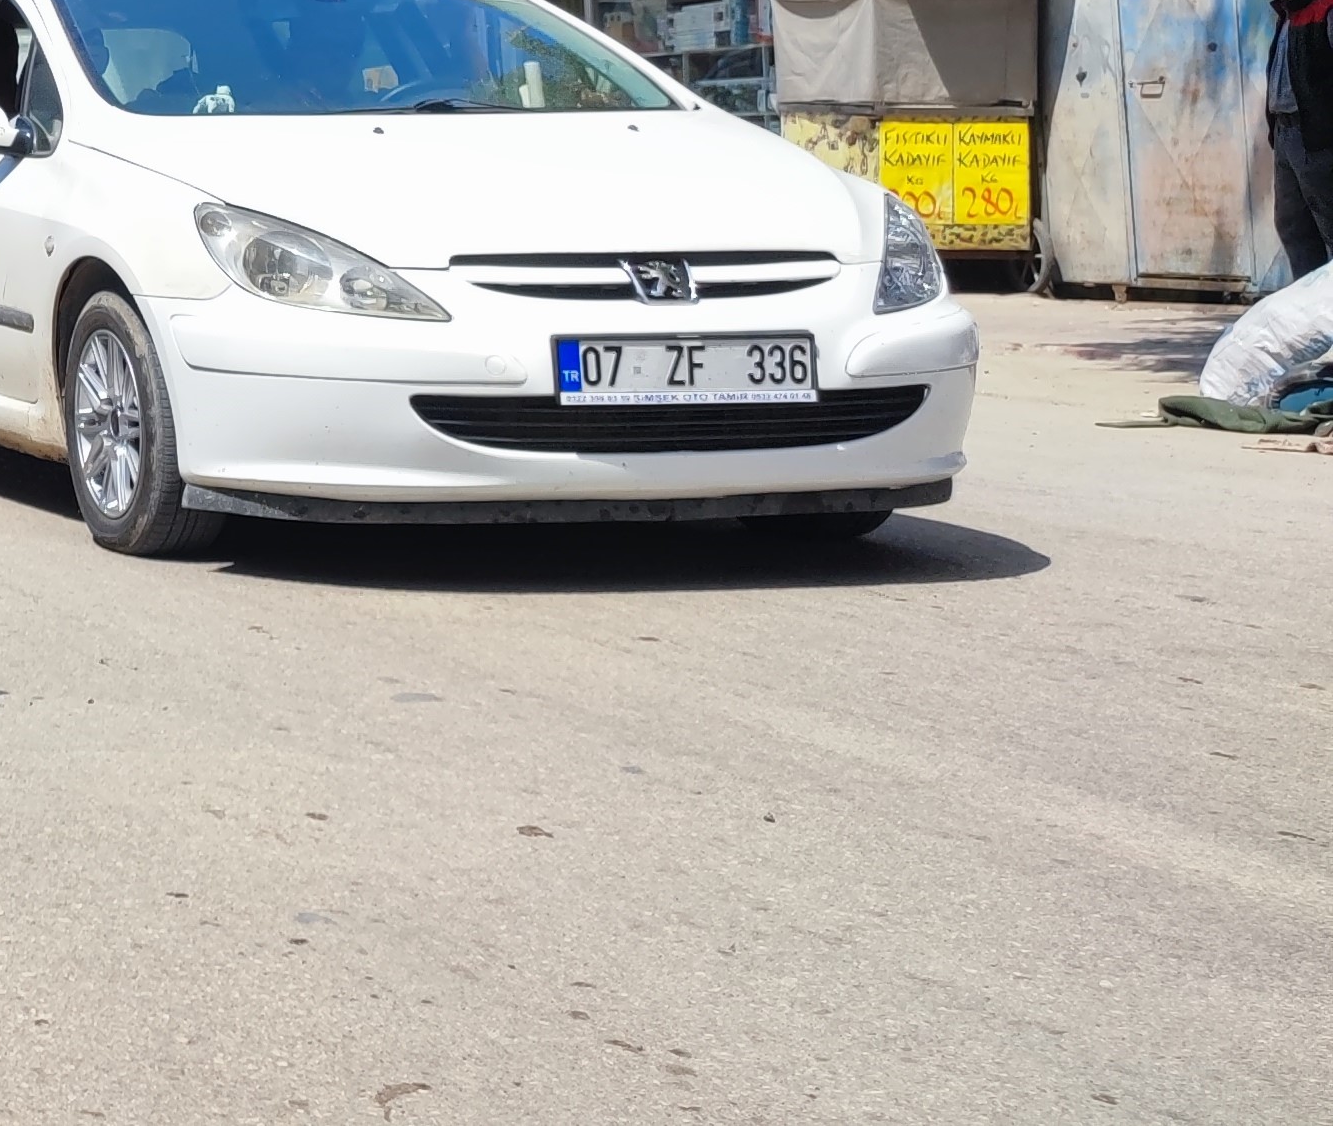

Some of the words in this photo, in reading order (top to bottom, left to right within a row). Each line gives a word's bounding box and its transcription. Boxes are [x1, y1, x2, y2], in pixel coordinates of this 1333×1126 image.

[884, 128, 947, 147] FISTIKLI
[958, 125, 1022, 146] KAYMAKLI
[883, 149, 946, 167] KADAYIF
[957, 149, 1021, 168] KADAYIF
[563, 369, 580, 383] TR
[582, 345, 623, 387] 07
[665, 345, 706, 386] ZF
[746, 344, 808, 385] 336
[683, 393, 708, 402] OTO
